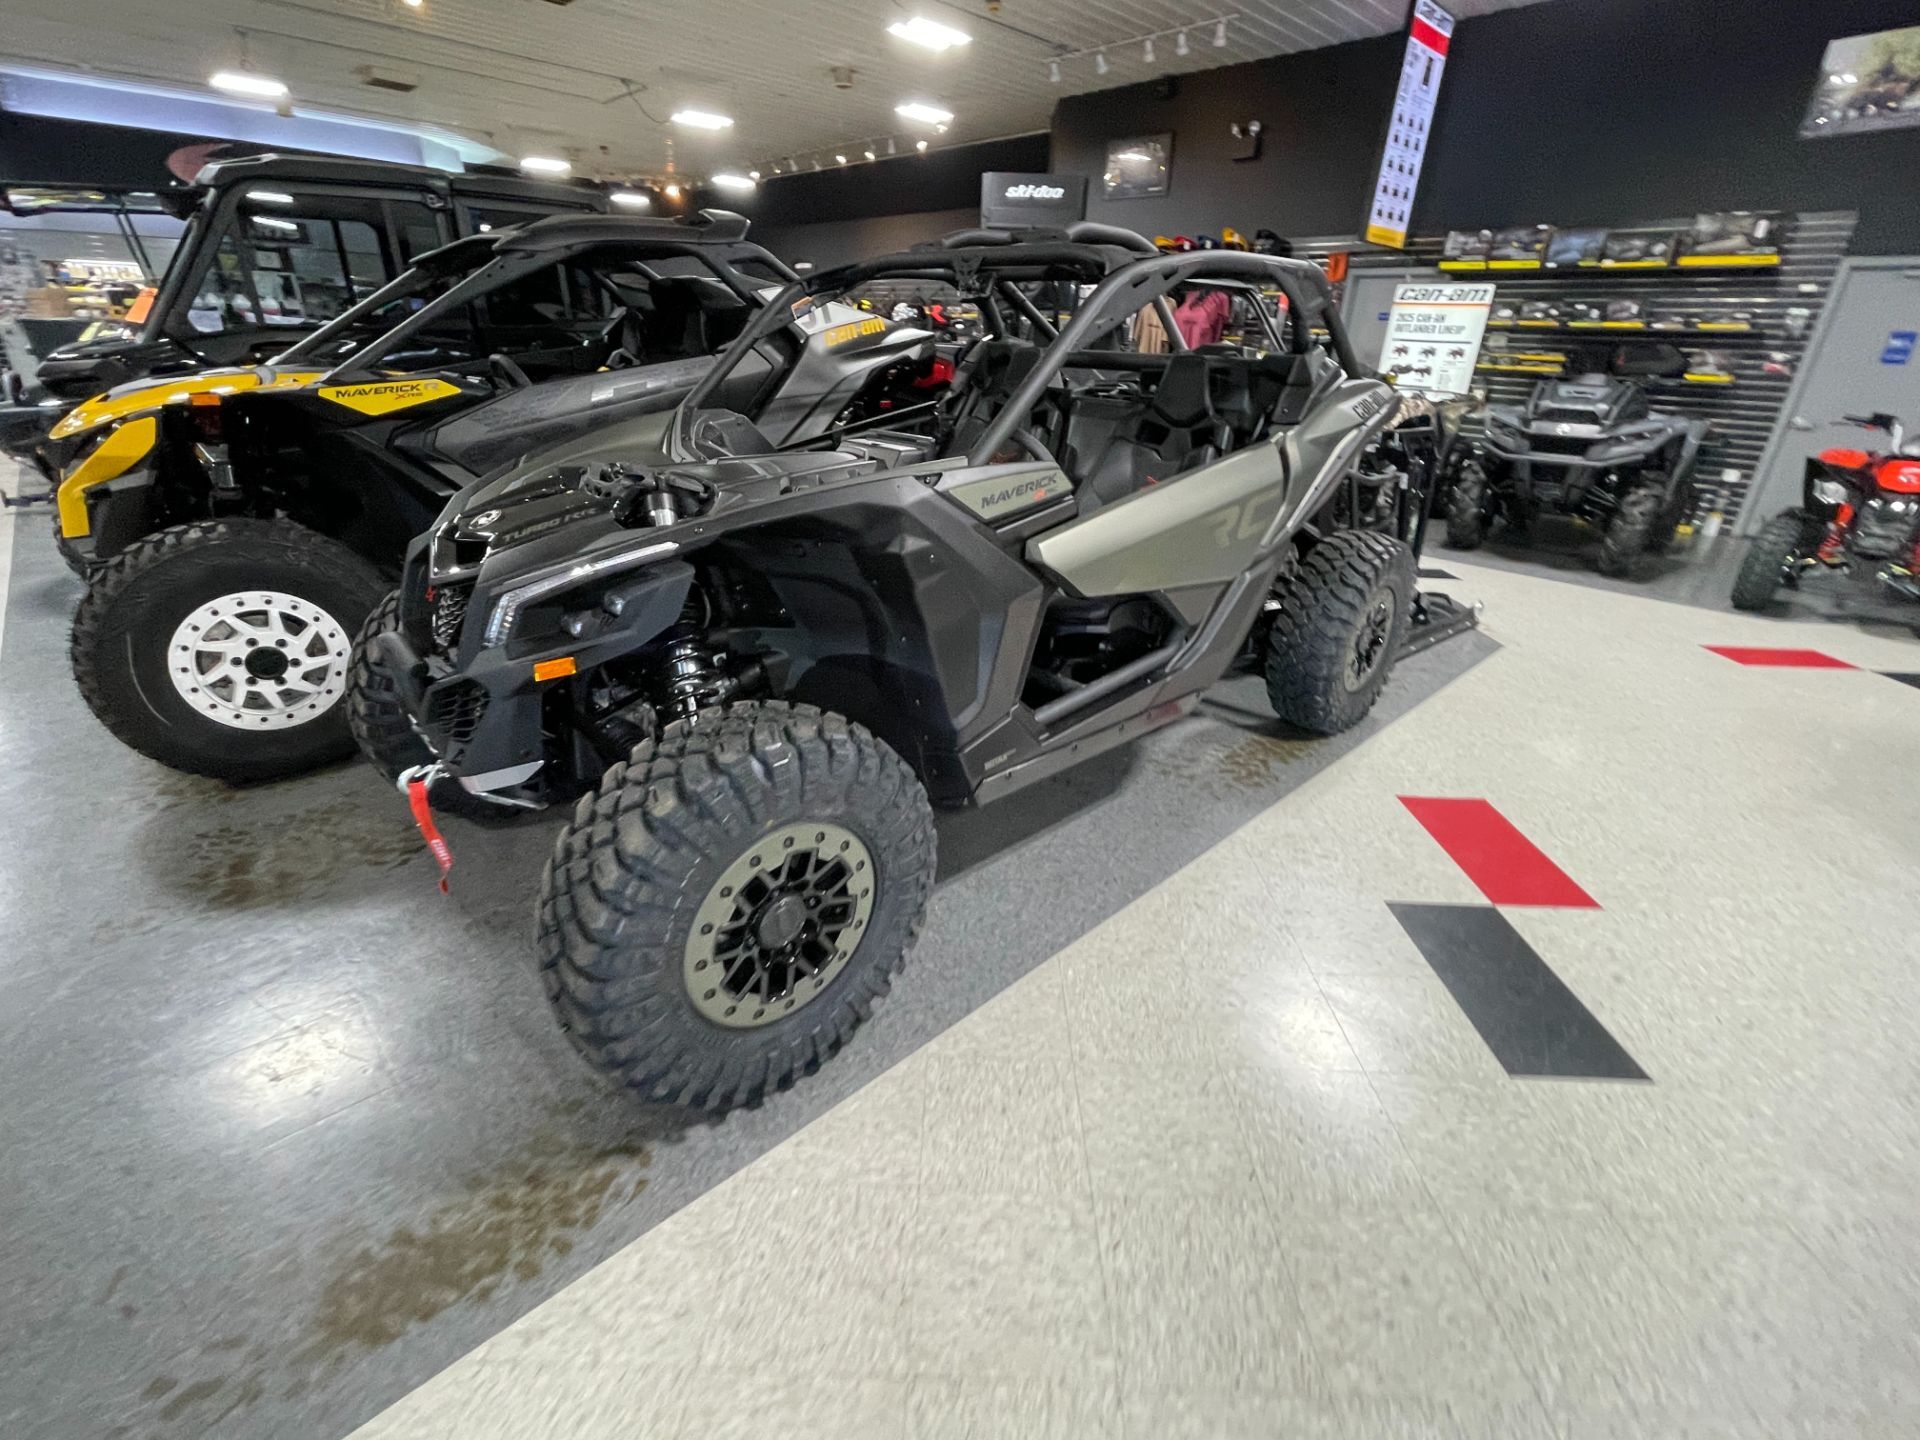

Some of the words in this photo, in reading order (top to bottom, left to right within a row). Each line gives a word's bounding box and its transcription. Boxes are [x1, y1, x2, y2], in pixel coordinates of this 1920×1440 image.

[1005, 185, 1065, 198] ski-doo
[1400, 288, 1490, 301] can-am
[335, 383, 421, 399] MAVERICK
[981, 473, 1058, 509] MAVERICK
[503, 516, 561, 542] TURBO
